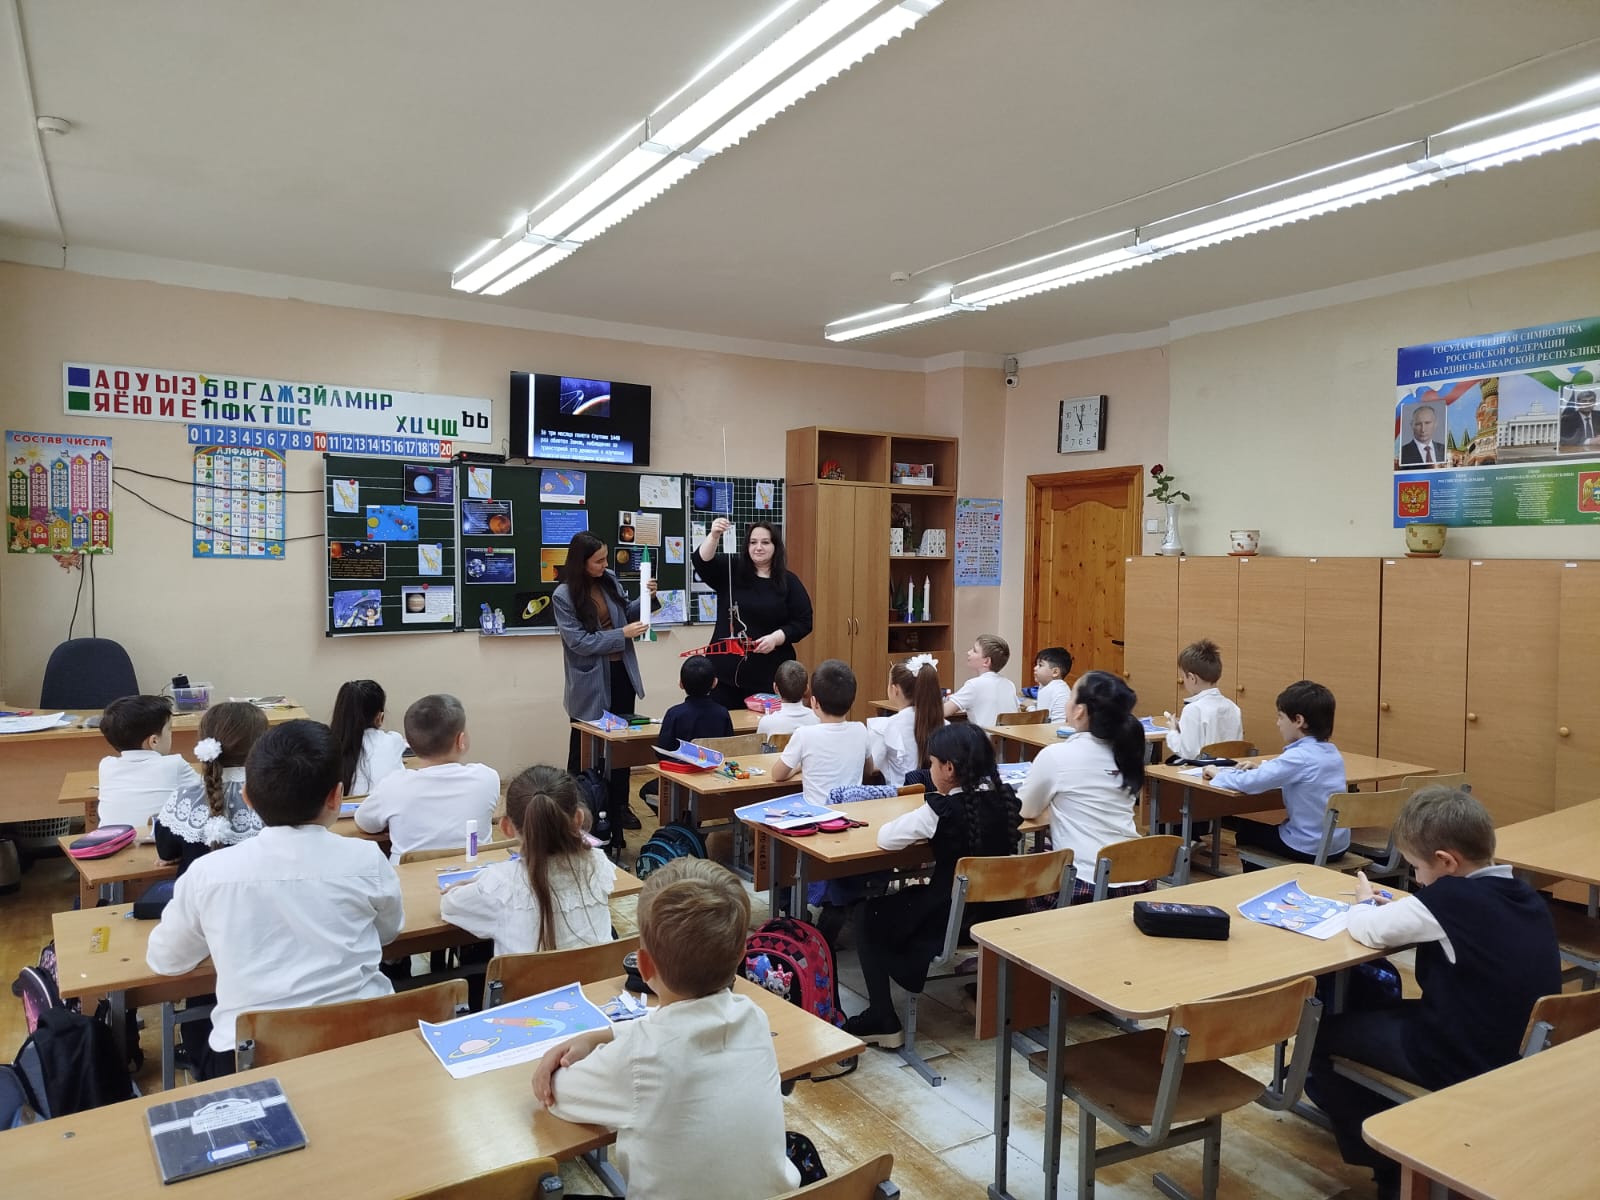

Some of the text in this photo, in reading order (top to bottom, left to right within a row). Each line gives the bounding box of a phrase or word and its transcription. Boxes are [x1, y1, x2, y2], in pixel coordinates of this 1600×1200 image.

[1432, 324, 1583, 354] ГОСУДАРСТВЕННАЯ СИМВОЛИКА
[1446, 339, 1566, 363] РОССИЙСКОЙ ФЕДЕРАЦИИ
[1414, 370, 1421, 378] И
[1421, 353, 1535, 377] КАБАРДИНО-БАЛКАРСКОЙ
[13, 434, 107, 447] СОСТАВ ЧИСЛА
[191, 428, 452, 456] 0 1 2 3 4 5 6 7 8 9 10 11 12 13 14 15 16 17 18 19 20
[216, 447, 265, 457] АЛФАВИТ
